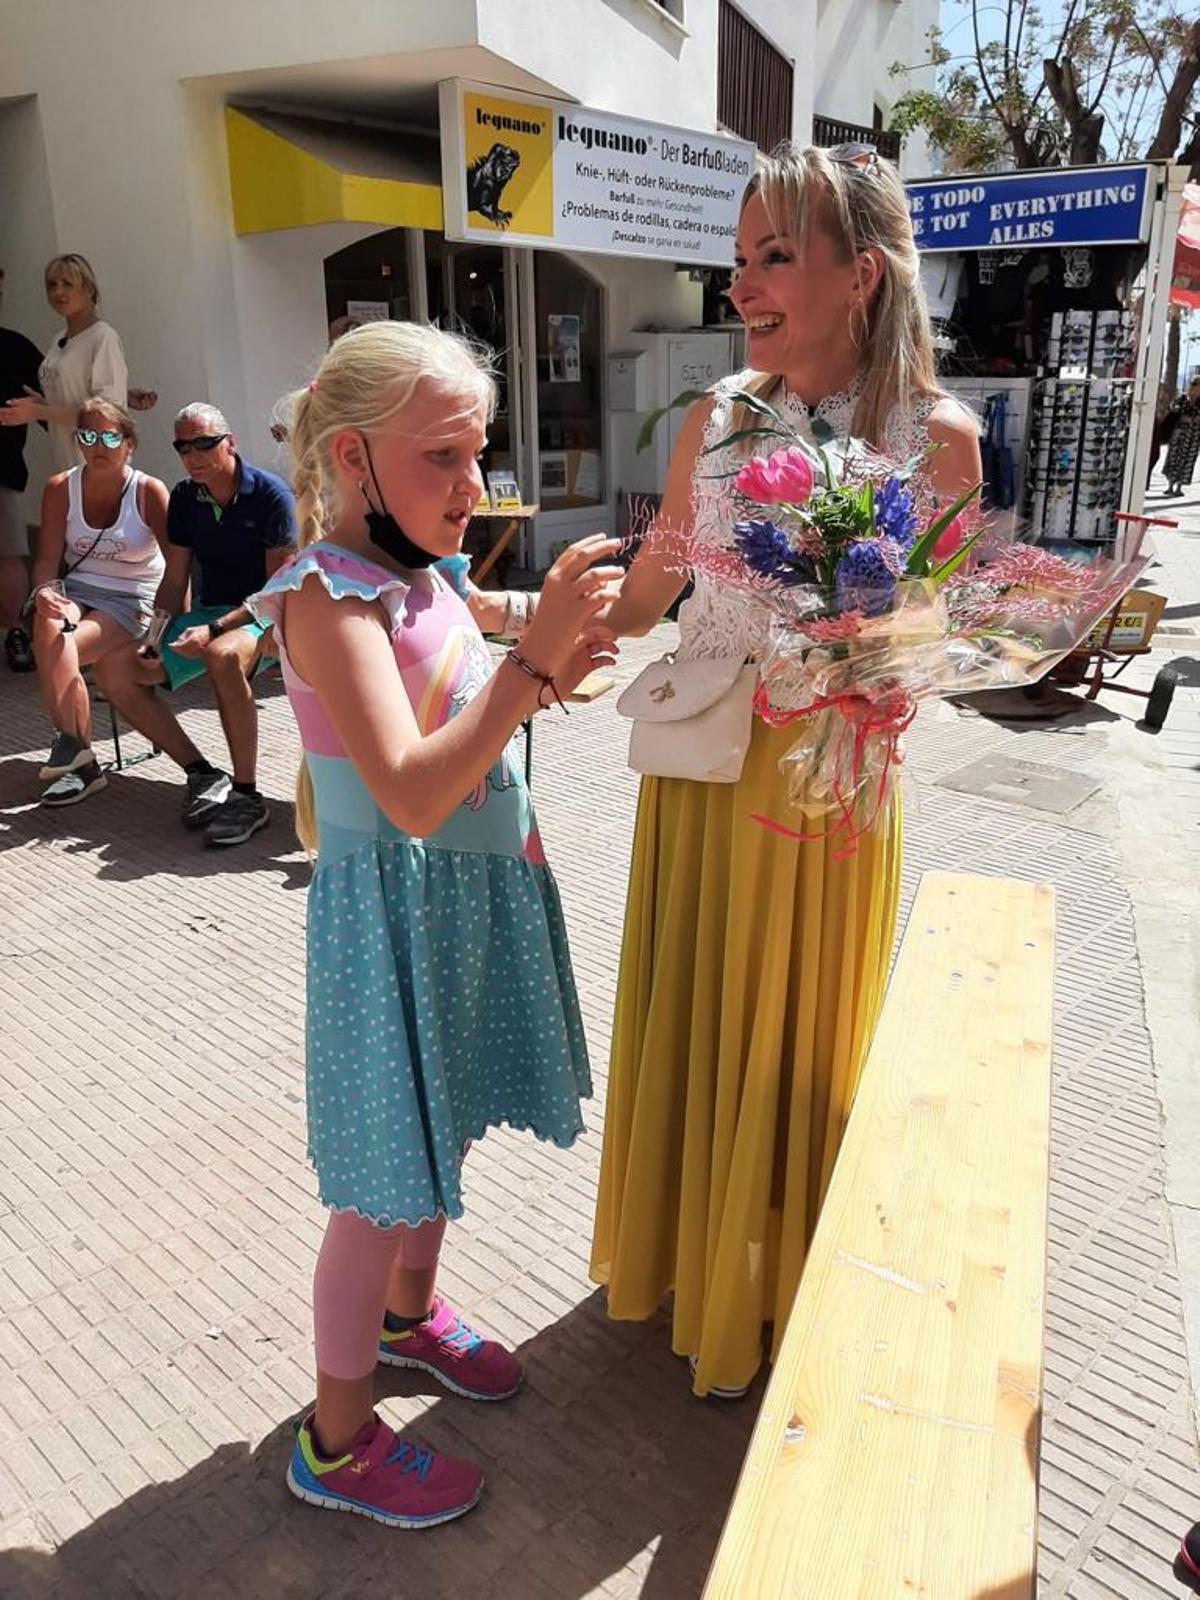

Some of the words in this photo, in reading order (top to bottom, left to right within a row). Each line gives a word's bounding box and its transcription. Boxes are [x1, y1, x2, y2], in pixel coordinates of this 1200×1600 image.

[661, 139, 680, 162] Der
[682, 143, 749, 175] Barfußladen
[576, 162, 605, 182] Knie-,
[608, 168, 633, 184] Hüft-
[635, 174, 657, 188] oder
[659, 176, 735, 200] Rückenprobleme?
[610, 190, 636, 205] Barfuß
[931, 186, 986, 210] TODO
[990, 184, 1137, 221] EVERYTHING
[562, 201, 619, 221] ¿Problemas
[621, 209, 634, 223] de
[636, 212, 671, 230] rodillas,
[673, 218, 702, 232] cadera
[703, 224, 710, 233] o
[711, 223, 737, 237] espald
[912, 218, 924, 235] E
[931, 212, 970, 233] TOT
[989, 220, 1054, 245] ALLES
